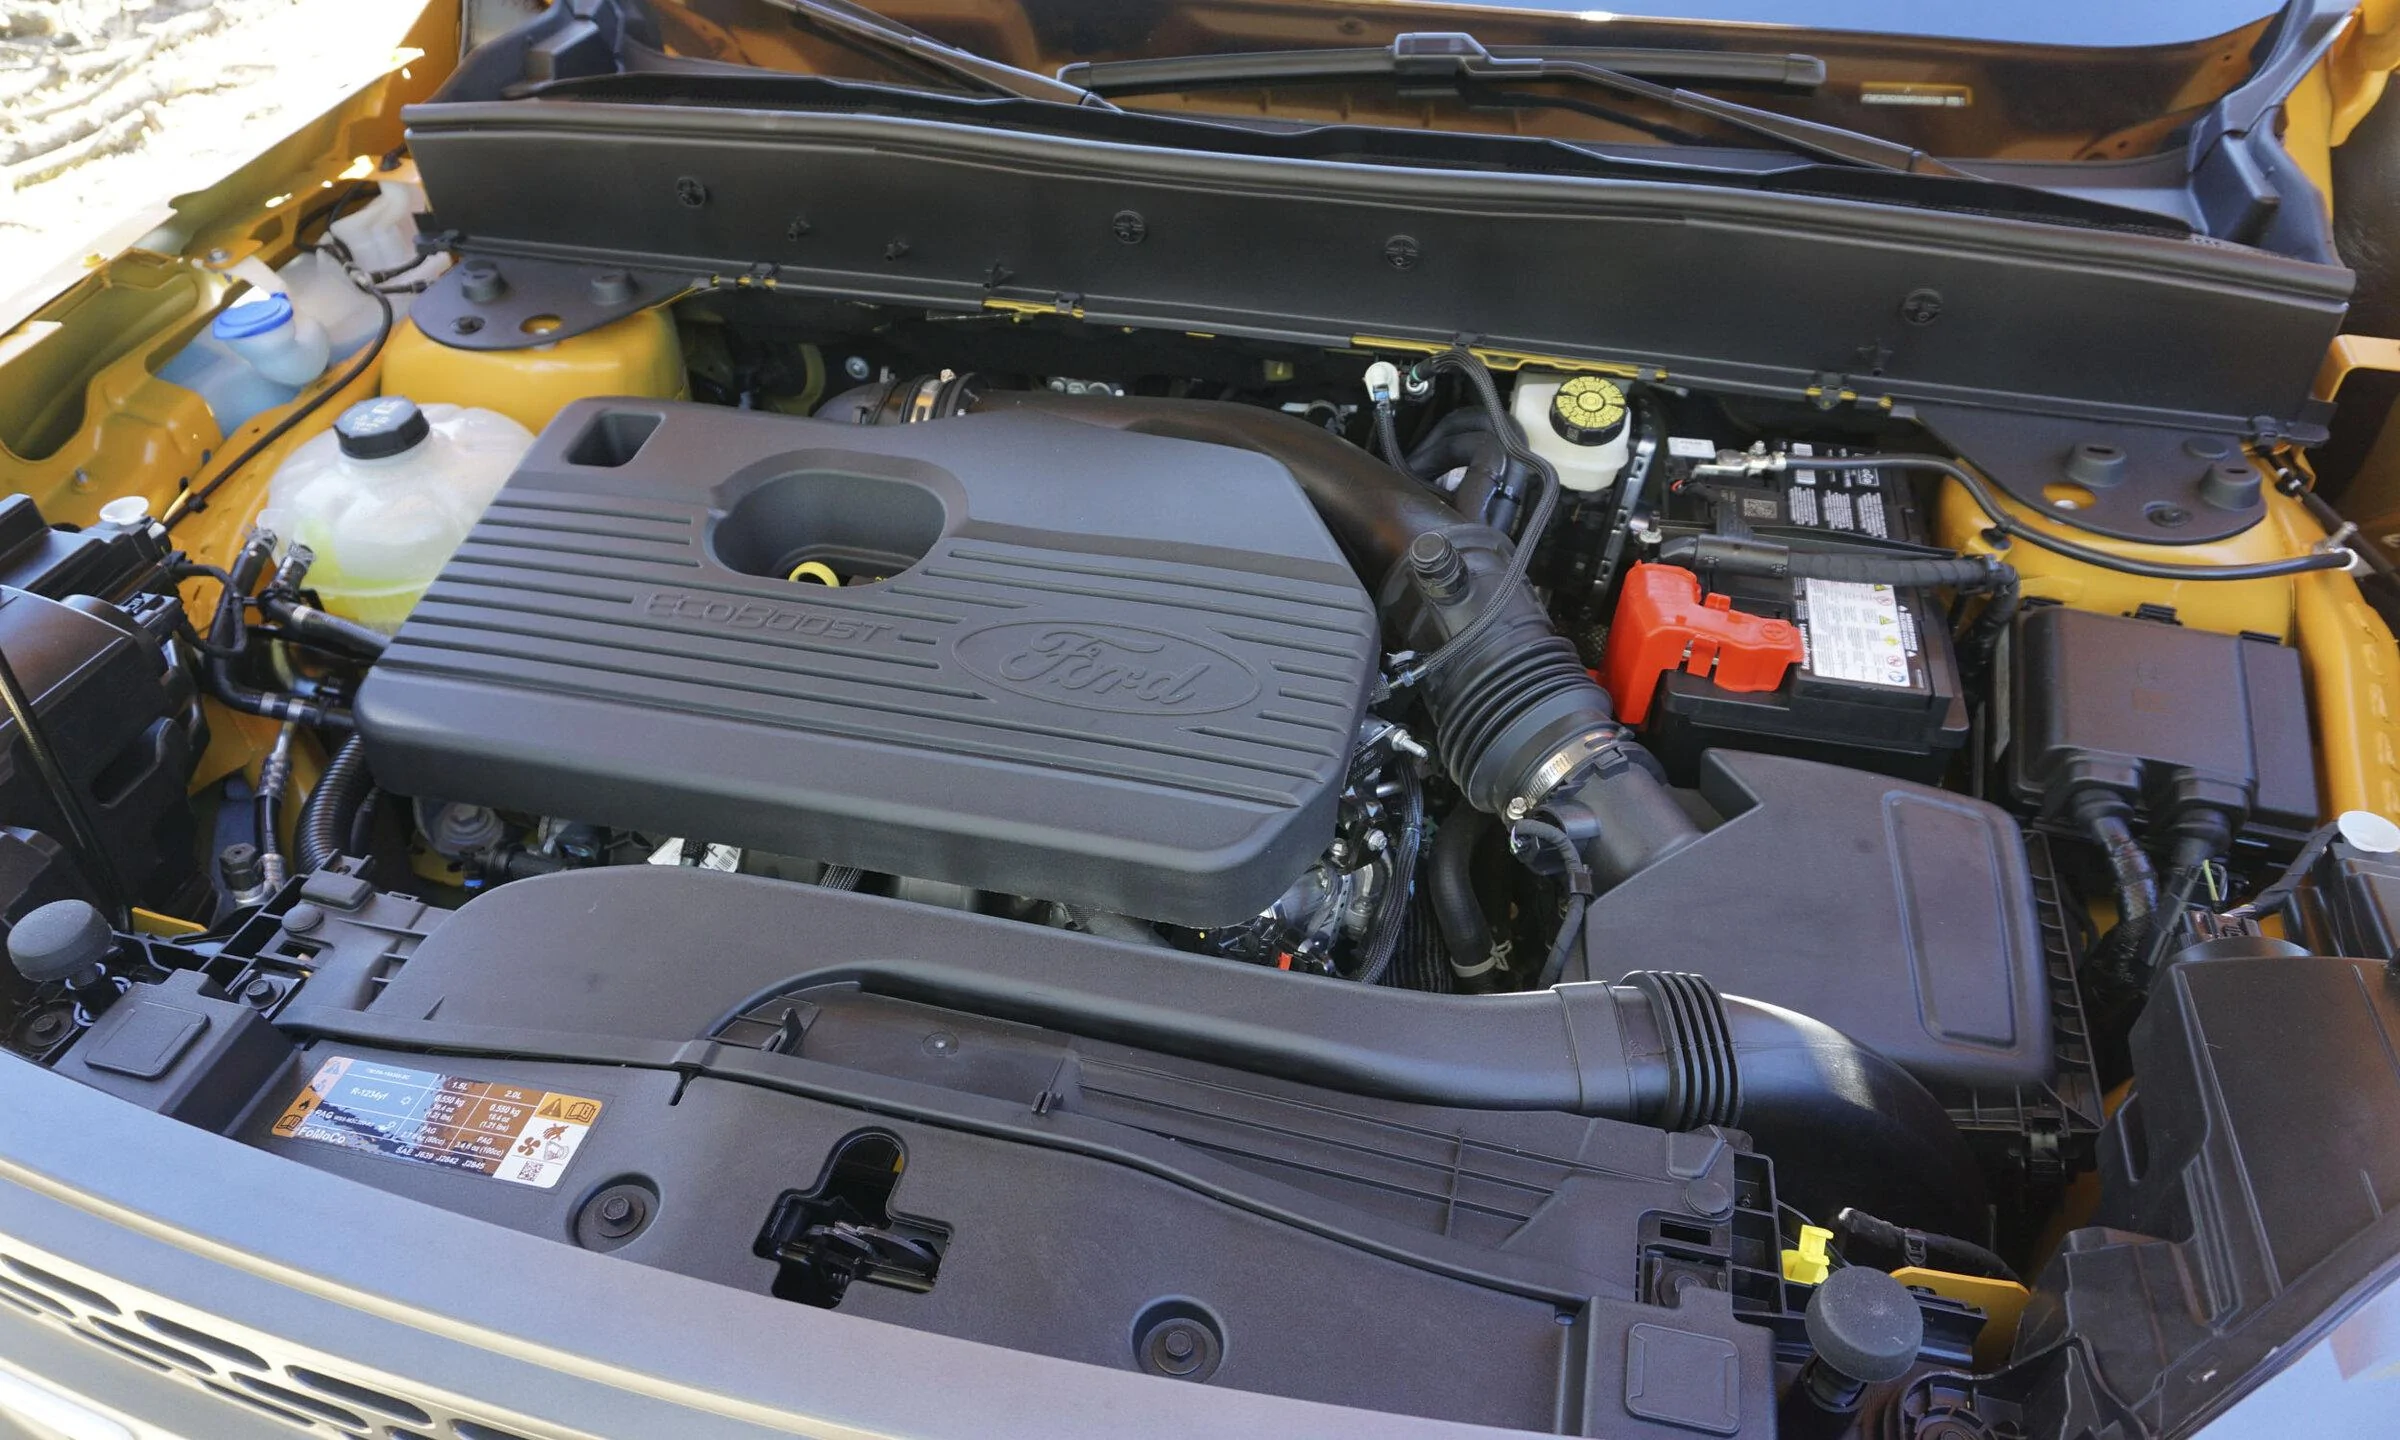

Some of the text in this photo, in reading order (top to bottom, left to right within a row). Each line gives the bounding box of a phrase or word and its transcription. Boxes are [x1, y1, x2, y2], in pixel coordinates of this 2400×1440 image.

[999, 630, 1210, 706] Ford
[451, 1081, 468, 1091] 1.5L
[350, 1087, 389, 1101] R-1234yf
[504, 1090, 522, 1100] 2.0L
[315, 1109, 334, 1119] PAG
[510, 1107, 521, 1118] kg
[299, 1126, 346, 1144] FoMoCo
[420, 1125, 437, 1135] PAG
[476, 1136, 493, 1145] PAG
[395, 1146, 413, 1156] SAE
[414, 1150, 435, 1160] J639
